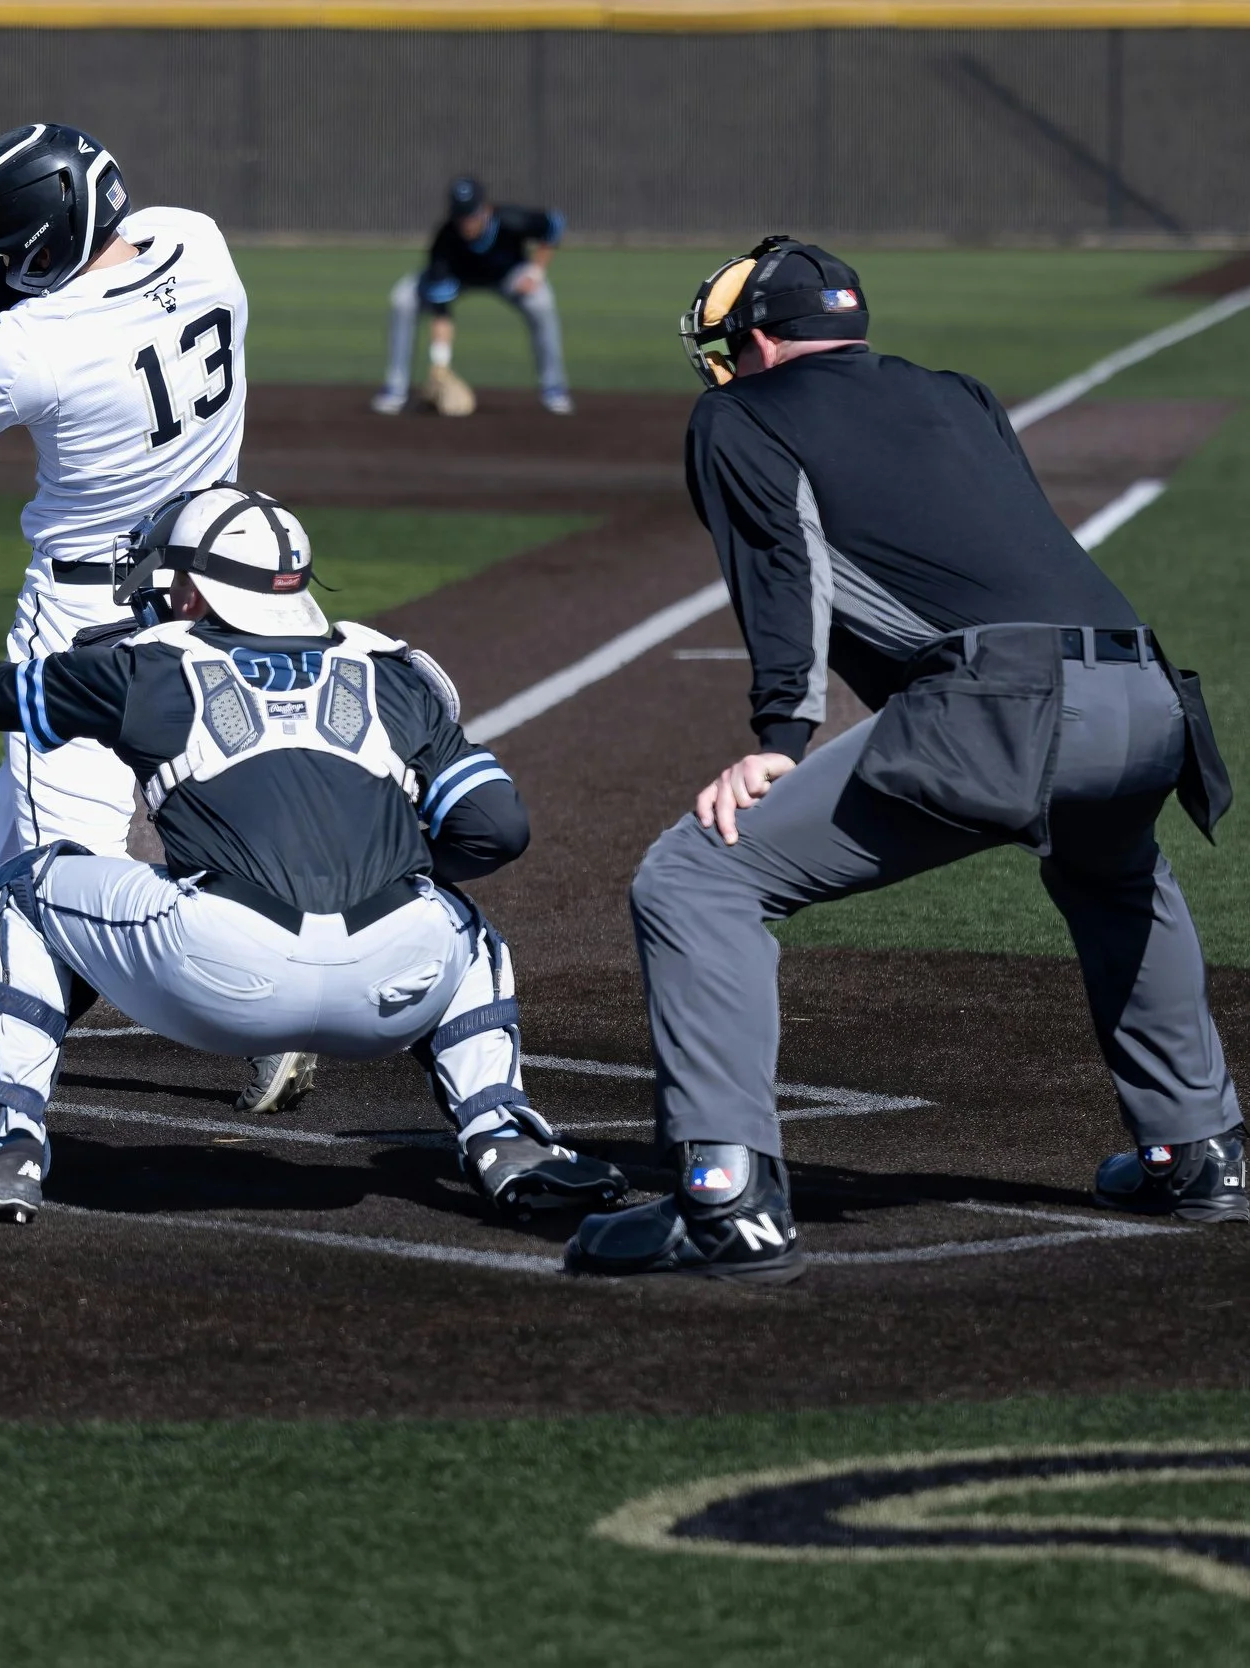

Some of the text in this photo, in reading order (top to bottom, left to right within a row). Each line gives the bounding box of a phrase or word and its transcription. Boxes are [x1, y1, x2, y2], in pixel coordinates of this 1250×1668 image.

[24, 222, 49, 248] EASTON
[130, 303, 235, 452] 13
[734, 1212, 784, 1251] N
